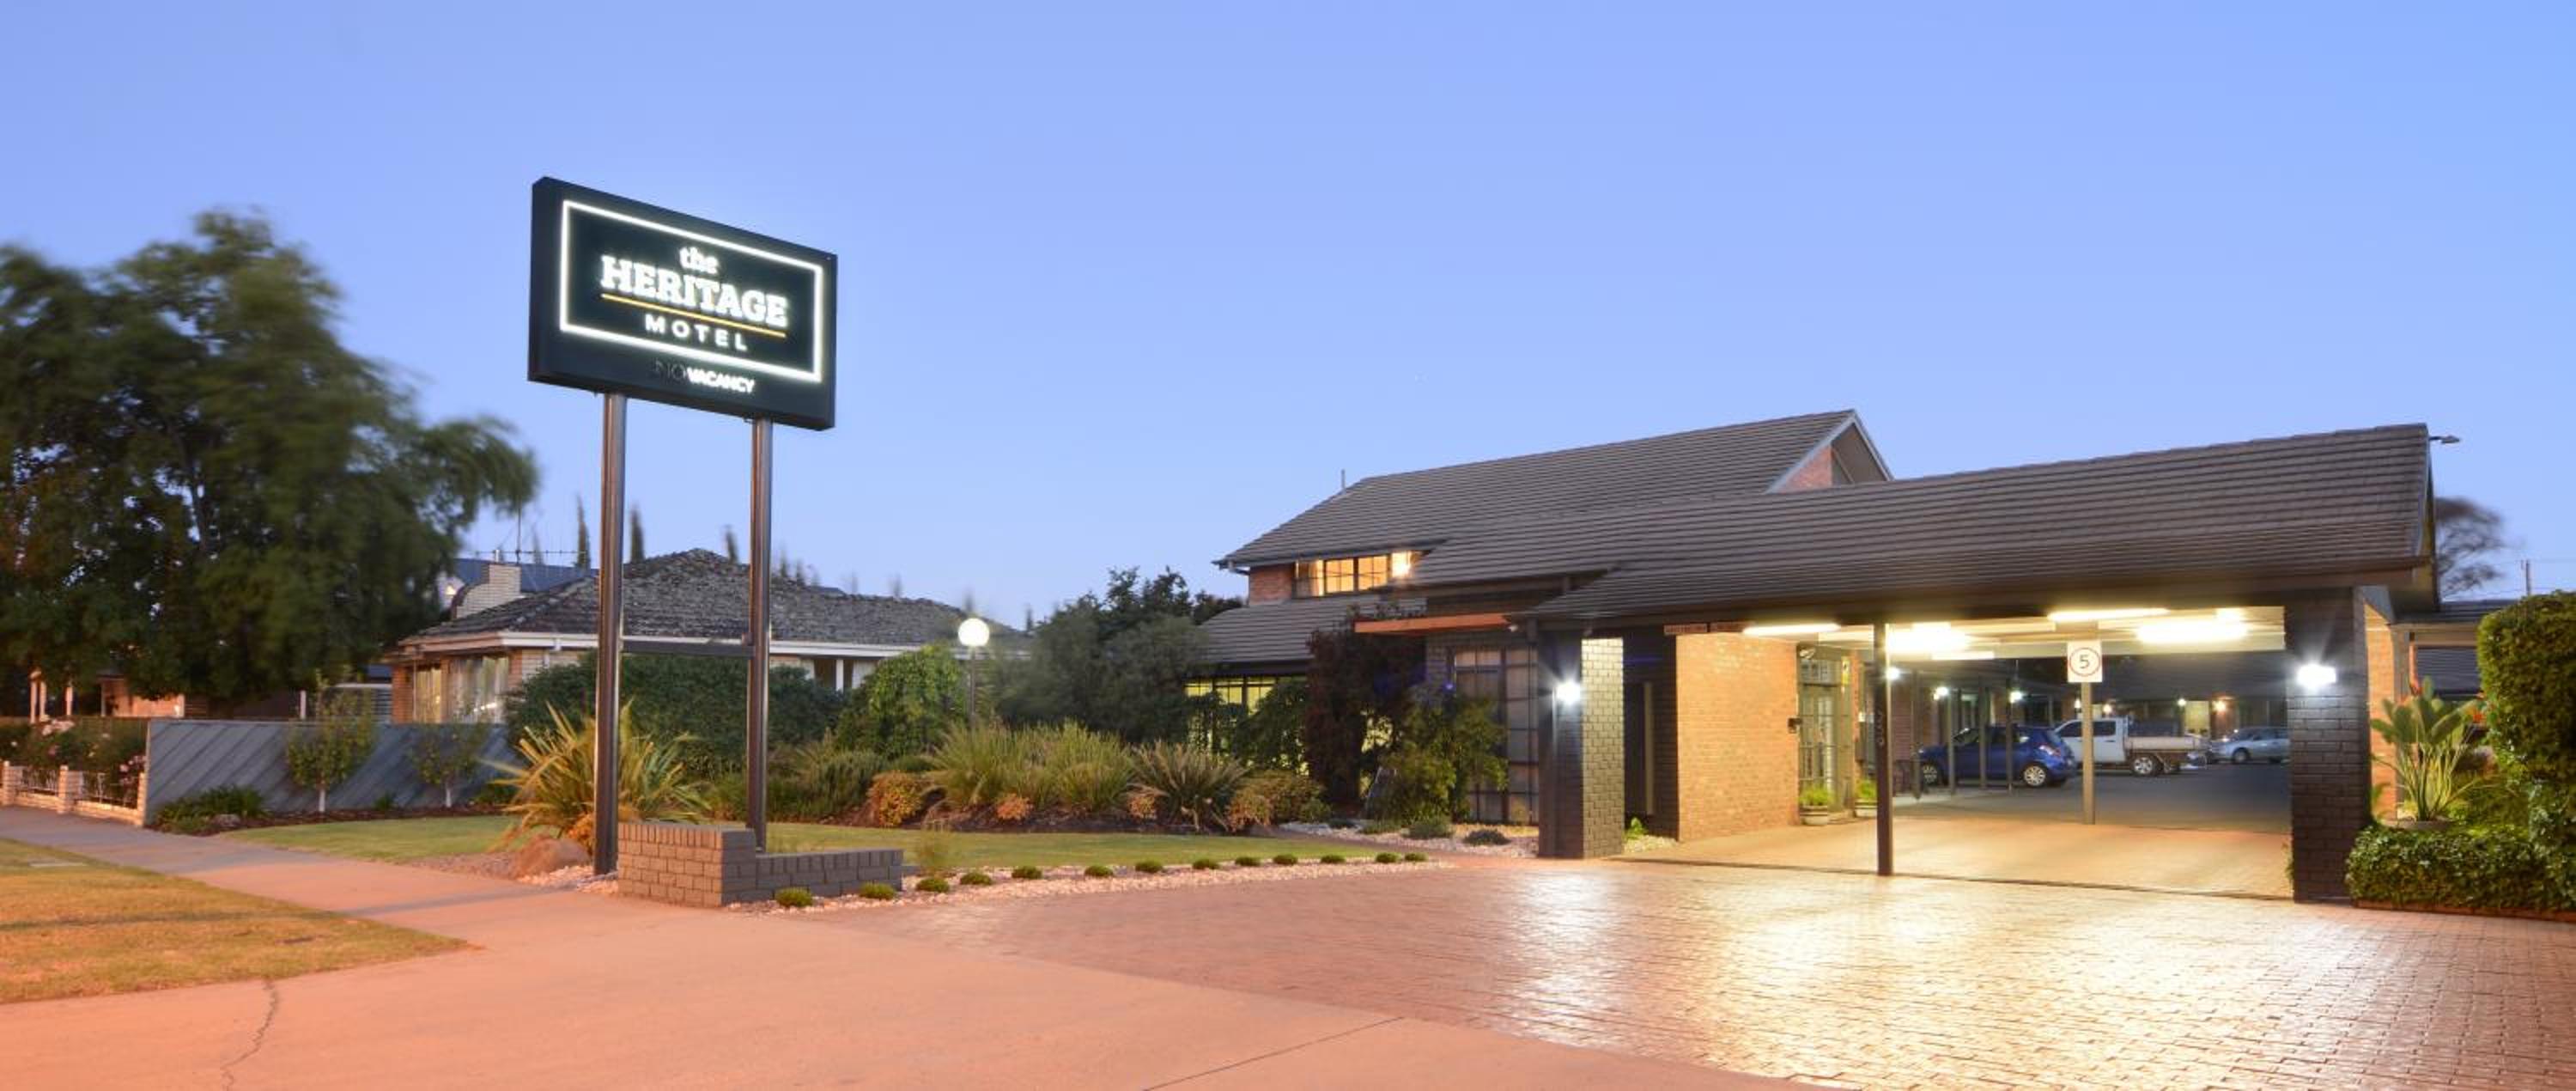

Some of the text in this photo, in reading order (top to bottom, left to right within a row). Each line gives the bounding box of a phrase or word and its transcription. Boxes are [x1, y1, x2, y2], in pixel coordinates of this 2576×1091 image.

[679, 247, 719, 274] the
[601, 255, 787, 327] HERITAGE
[645, 314, 747, 350] MOTEL
[687, 366, 755, 393] VACANCY
[2079, 654, 2091, 669] 5
